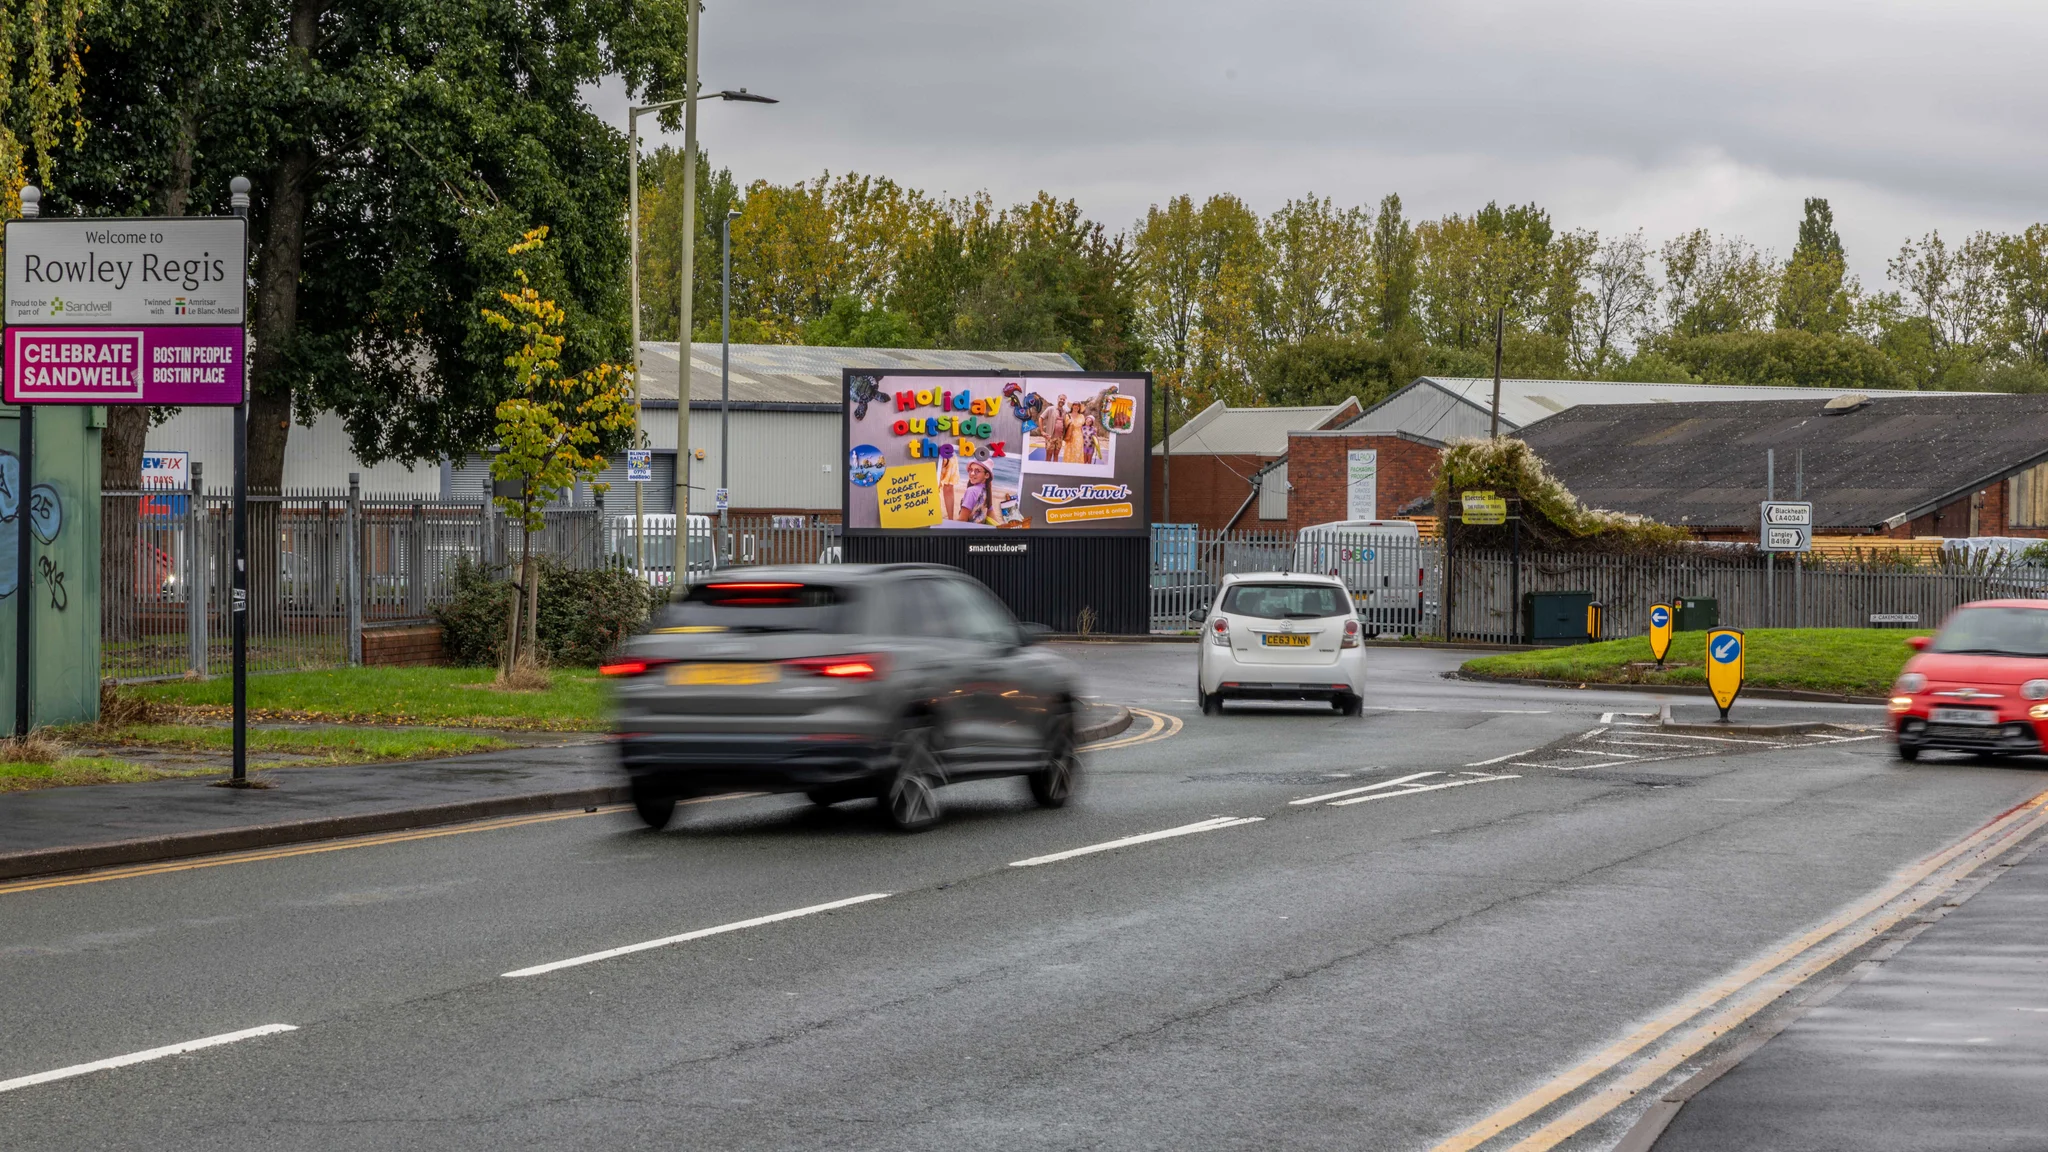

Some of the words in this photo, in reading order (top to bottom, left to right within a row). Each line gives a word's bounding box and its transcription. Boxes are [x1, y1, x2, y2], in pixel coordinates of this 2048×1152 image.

[86, 230, 147, 244] Welcome
[150, 232, 163, 244] to
[24, 251, 133, 290] Rowley
[142, 251, 225, 291] Regis
[10, 299, 30, 307] Proud
[38, 299, 47, 307] be
[65, 300, 112, 312] Sandwell
[144, 298, 172, 306] Twinned
[188, 298, 216, 306] Amritsar
[18, 308, 31, 317] part
[32, 307, 40, 316] of
[150, 307, 164, 315] with
[188, 307, 196, 315] Le
[197, 306, 240, 315] Blanc-Mesnil
[24, 343, 132, 363] CELEBRATE
[153, 346, 191, 364] BOSTIN
[193, 346, 232, 363] PEOPLE
[24, 366, 131, 386] SANDWELL
[153, 367, 191, 384] BOSTIN
[193, 367, 225, 383] PLACE
[895, 385, 1003, 416] Holiday
[893, 415, 993, 439] outside
[908, 437, 955, 459] the
[958, 437, 1007, 461] box
[141, 457, 182, 470] EWFIX
[153, 475, 174, 484] DAYS
[891, 473, 917, 485] DON'T
[883, 495, 902, 505] KIDS
[904, 488, 933, 500] BREAK
[1042, 485, 1078, 501] Hays
[1081, 485, 1126, 499] Travel
[890, 504, 902, 512] UP
[904, 496, 929, 509] SOON!
[1060, 512, 1073, 520] your
[1074, 510, 1087, 519] high
[1088, 508, 1105, 516] street
[1111, 506, 1128, 514] online
[969, 543, 1019, 552] smartoutdoor
[1267, 635, 1290, 645] CE63
[1291, 635, 1309, 645] YNK
